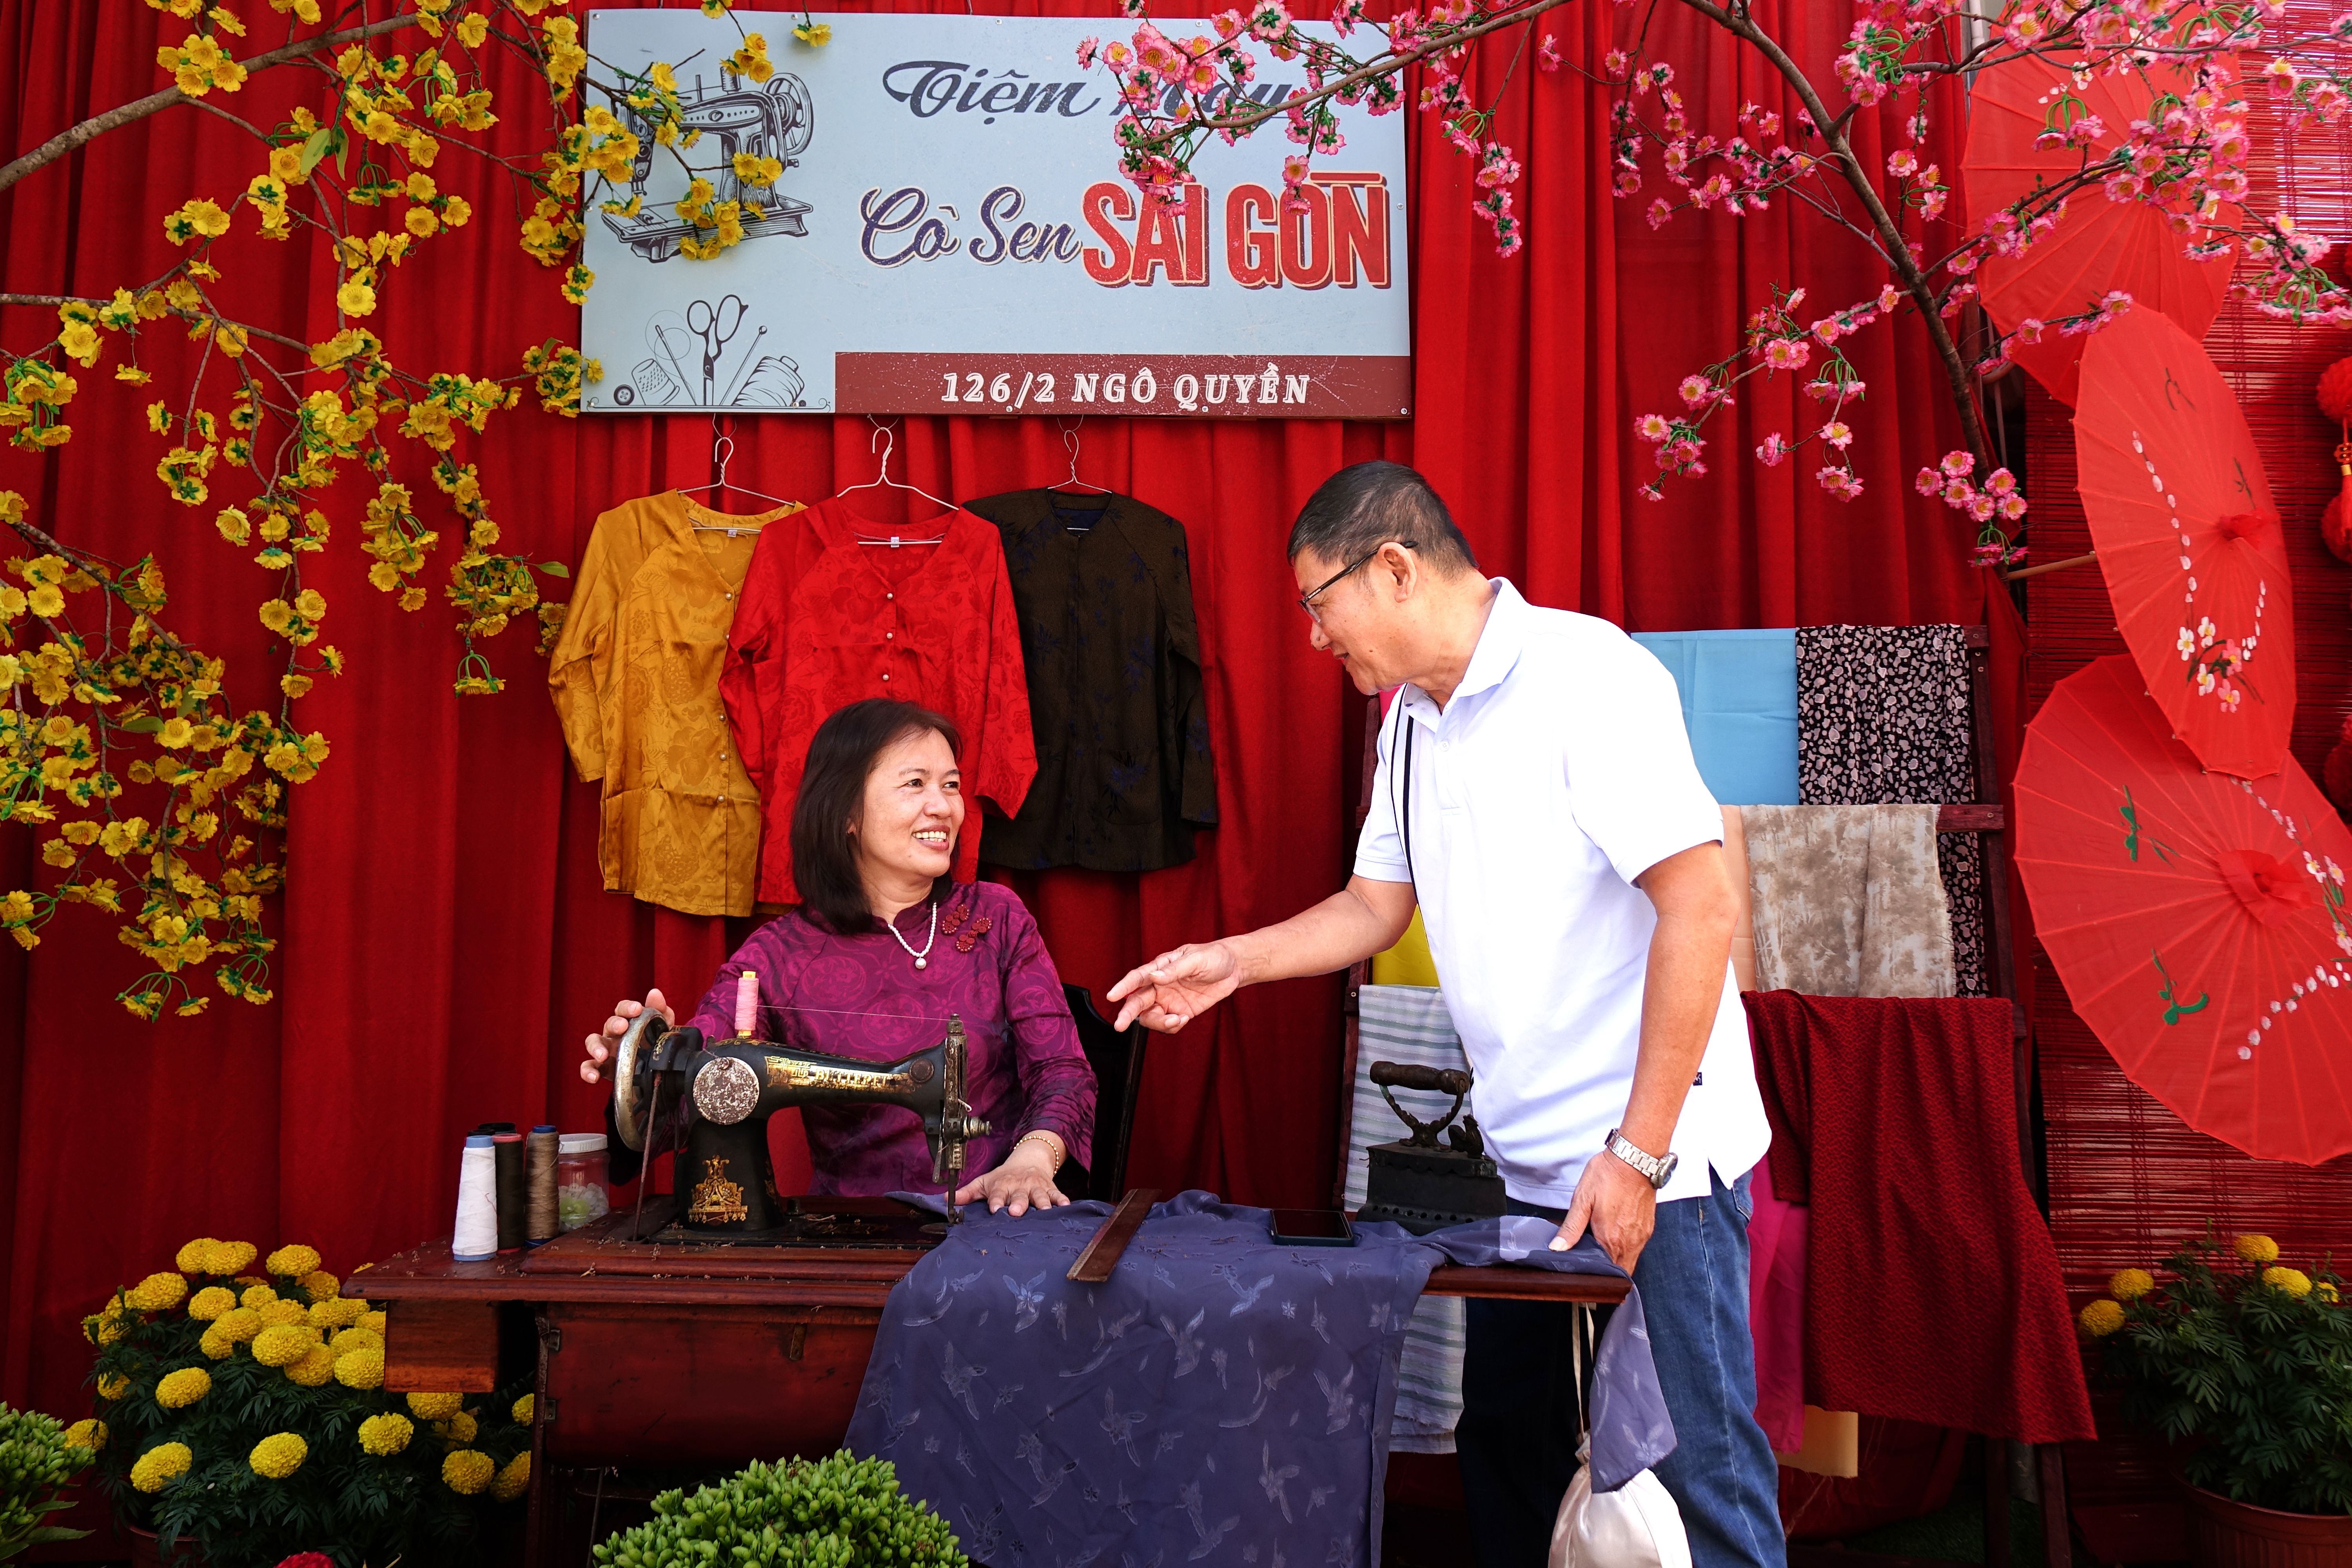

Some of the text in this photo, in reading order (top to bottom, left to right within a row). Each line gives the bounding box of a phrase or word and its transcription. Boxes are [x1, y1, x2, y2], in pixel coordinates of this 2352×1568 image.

[882, 60, 1102, 125] Tiệm
[967, 186, 1083, 266] Sen
[941, 361, 1310, 410] 126/2 NGÔ QUYỀN
